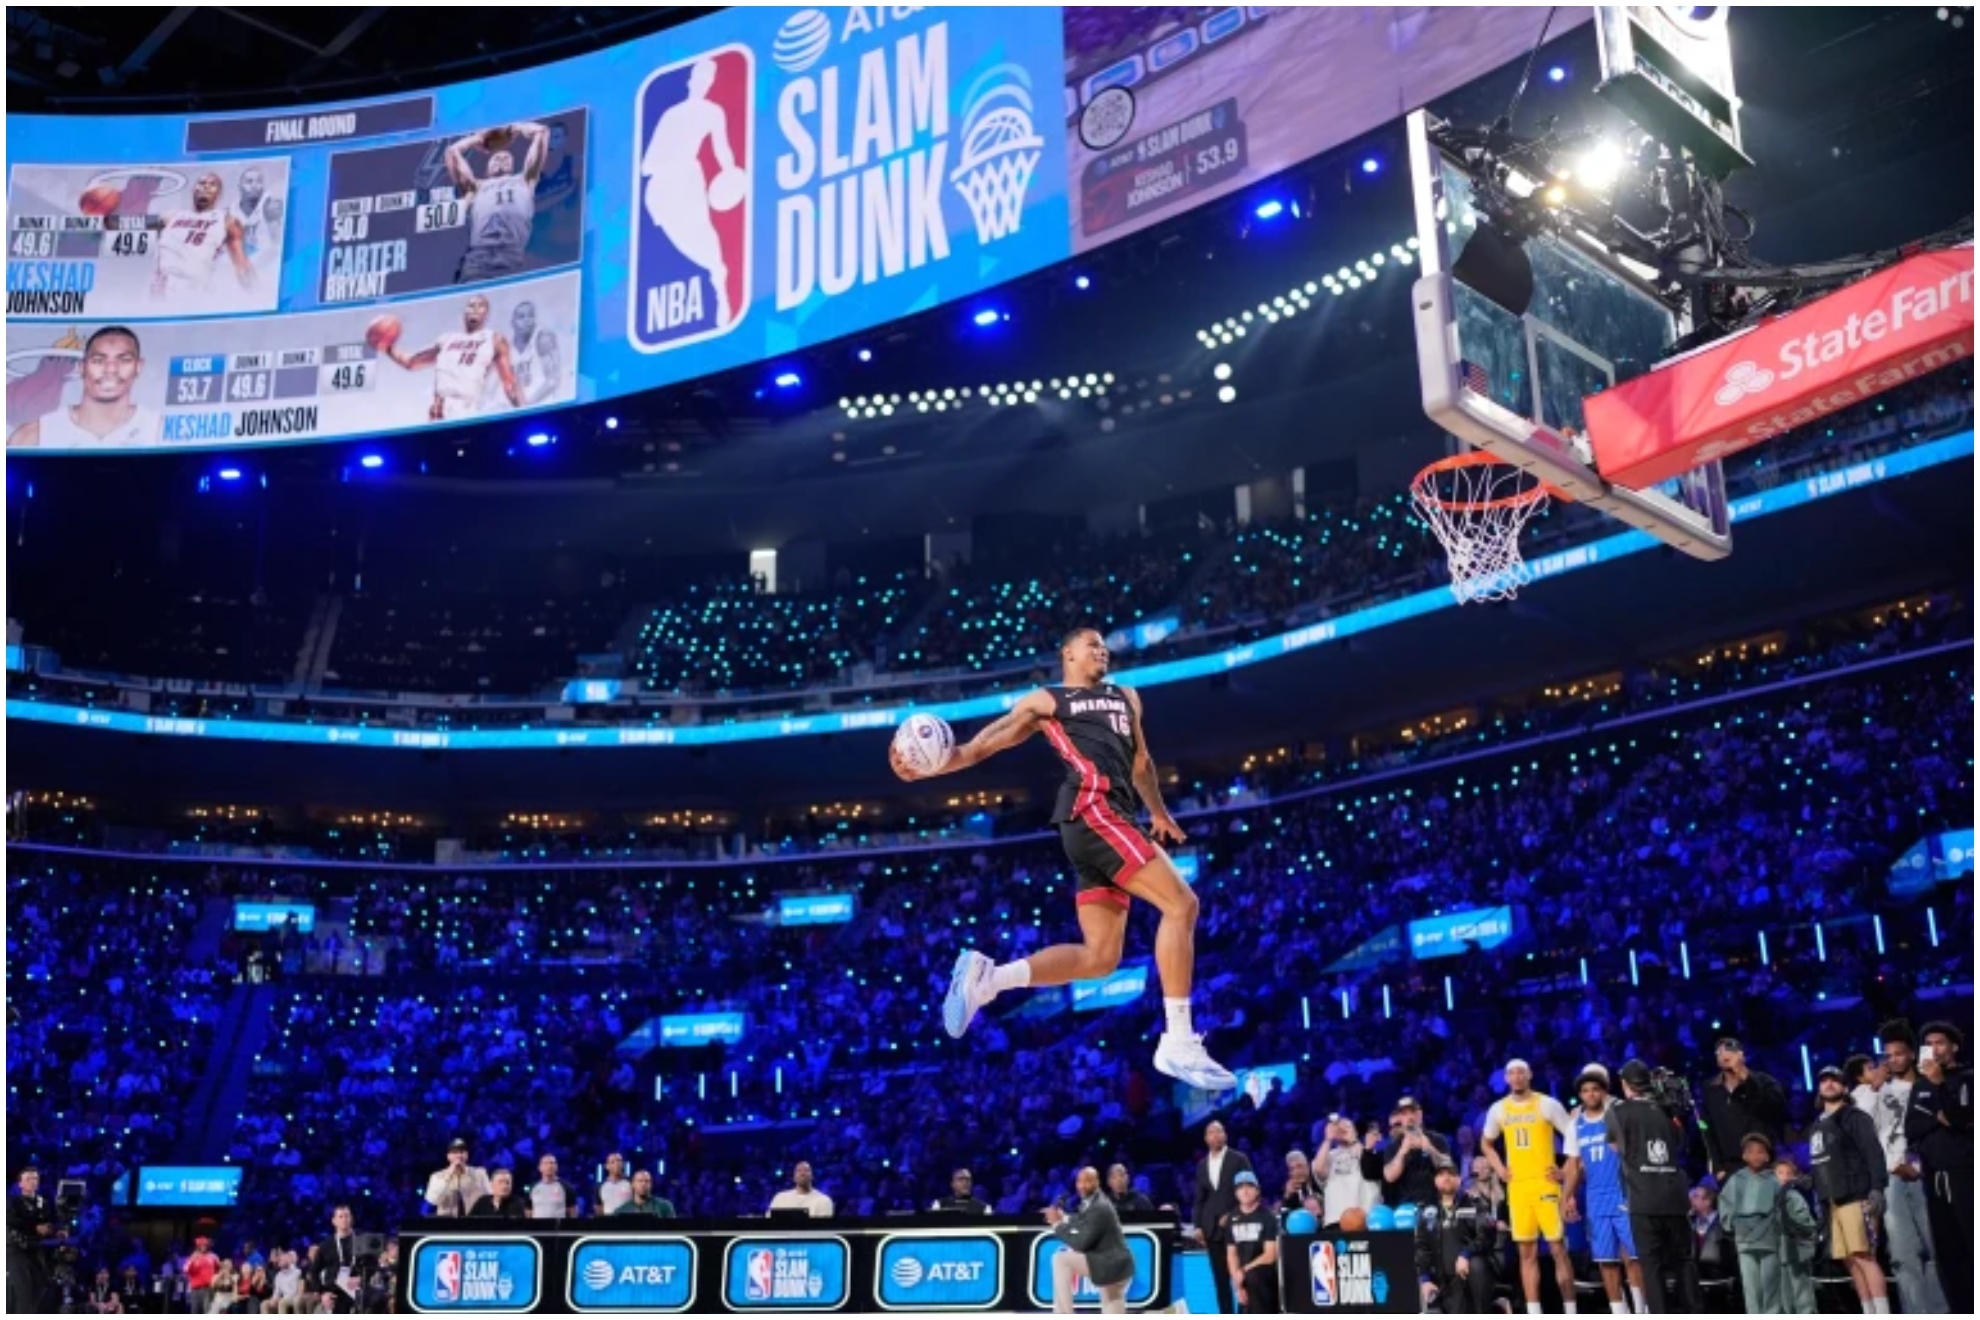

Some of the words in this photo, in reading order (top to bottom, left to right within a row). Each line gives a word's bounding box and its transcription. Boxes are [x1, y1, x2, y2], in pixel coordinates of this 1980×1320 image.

[776, 21, 949, 190] SLAM
[265, 118, 304, 144] FINAL
[308, 112, 357, 139] ROUND
[1197, 138, 1238, 175] 53.9
[185, 230, 207, 246] 16
[332, 215, 369, 242] 50.0
[776, 140, 952, 313] DUNK
[13, 231, 51, 257] 49.6
[111, 231, 148, 256] 49.6
[329, 238, 408, 279] CARTER
[6, 260, 96, 292] KESHAD
[325, 270, 386, 301] BRYANT
[6, 289, 87, 315] JOHNSON
[646, 276, 704, 333] NBA
[1778, 311, 1887, 380] State
[183, 357, 213, 373] CLOCK
[332, 363, 365, 389] 49.6
[177, 376, 212, 404] 53.7
[231, 372, 266, 400] 49.6
[1747, 387, 1856, 438] State
[1855, 342, 1965, 395] Farm
[163, 411, 233, 441] KESHAD
[235, 404, 318, 437] JOHNSON
[1069, 698, 1128, 715] MIAMI
[1109, 712, 1131, 736] 16
[464, 1261, 499, 1279] SLAM
[619, 1265, 676, 1285] AT&T
[775, 1258, 808, 1277] SLAM
[927, 1261, 984, 1281] AT&T
[1338, 1253, 1372, 1278] SLAM
[462, 1281, 497, 1300] DUNK
